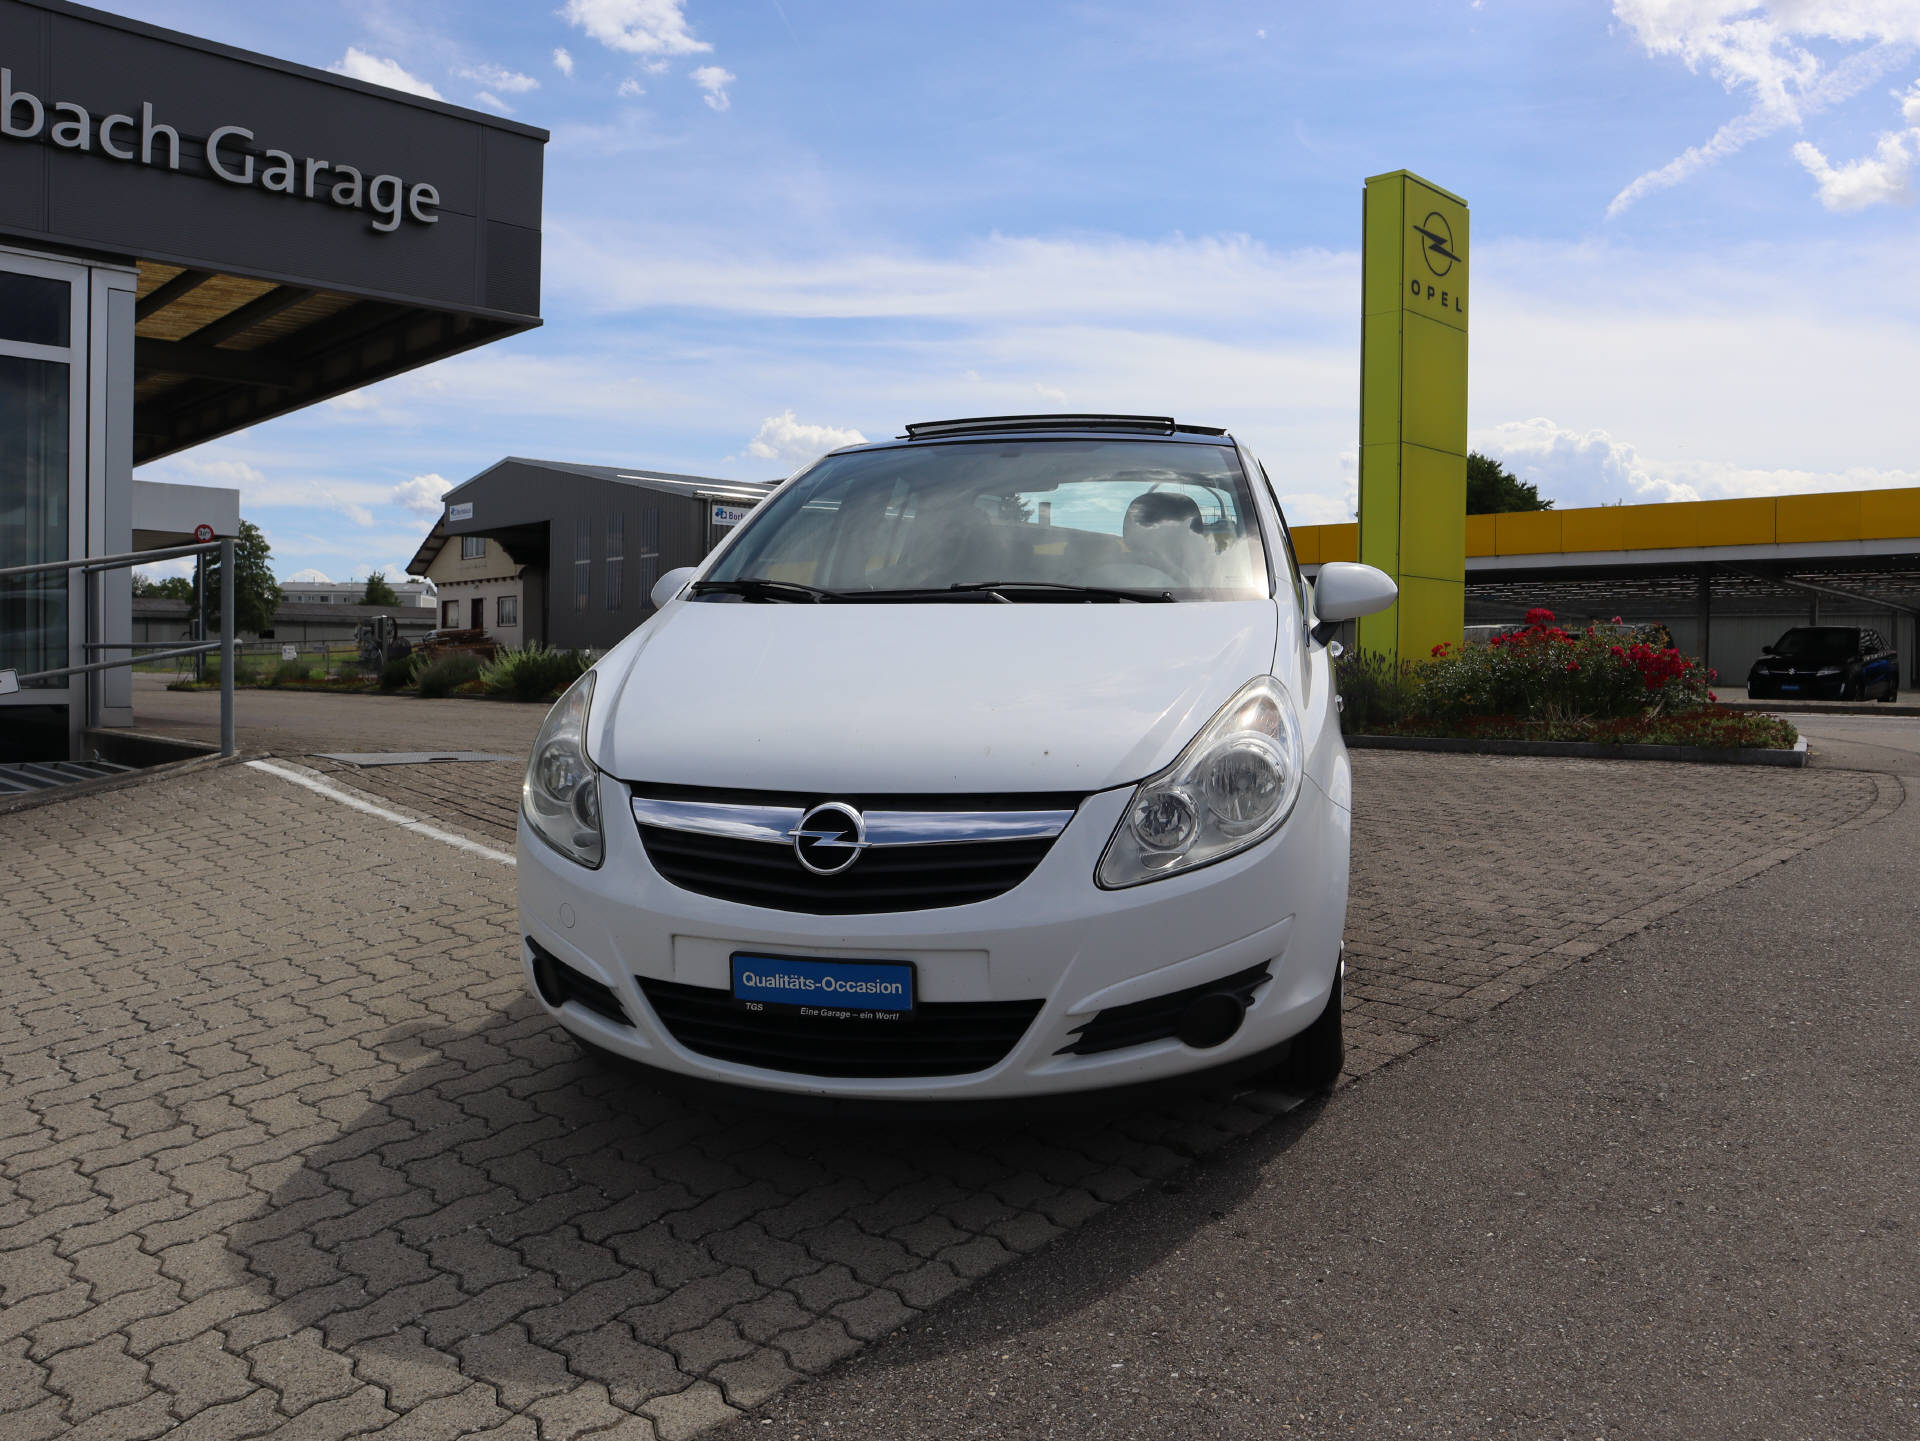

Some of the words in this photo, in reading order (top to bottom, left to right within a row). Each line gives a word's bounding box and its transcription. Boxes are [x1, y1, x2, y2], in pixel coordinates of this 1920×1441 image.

[0, 67, 180, 169] bach
[206, 125, 440, 231] Garage
[1411, 279, 1462, 312] OPEL
[742, 971, 902, 994] Qualitäts-Occasion
[745, 1002, 764, 1011] TGS
[800, 1008, 819, 1016] Eine
[820, 1009, 850, 1018] Garage
[876, 1012, 899, 1021] Wort!
